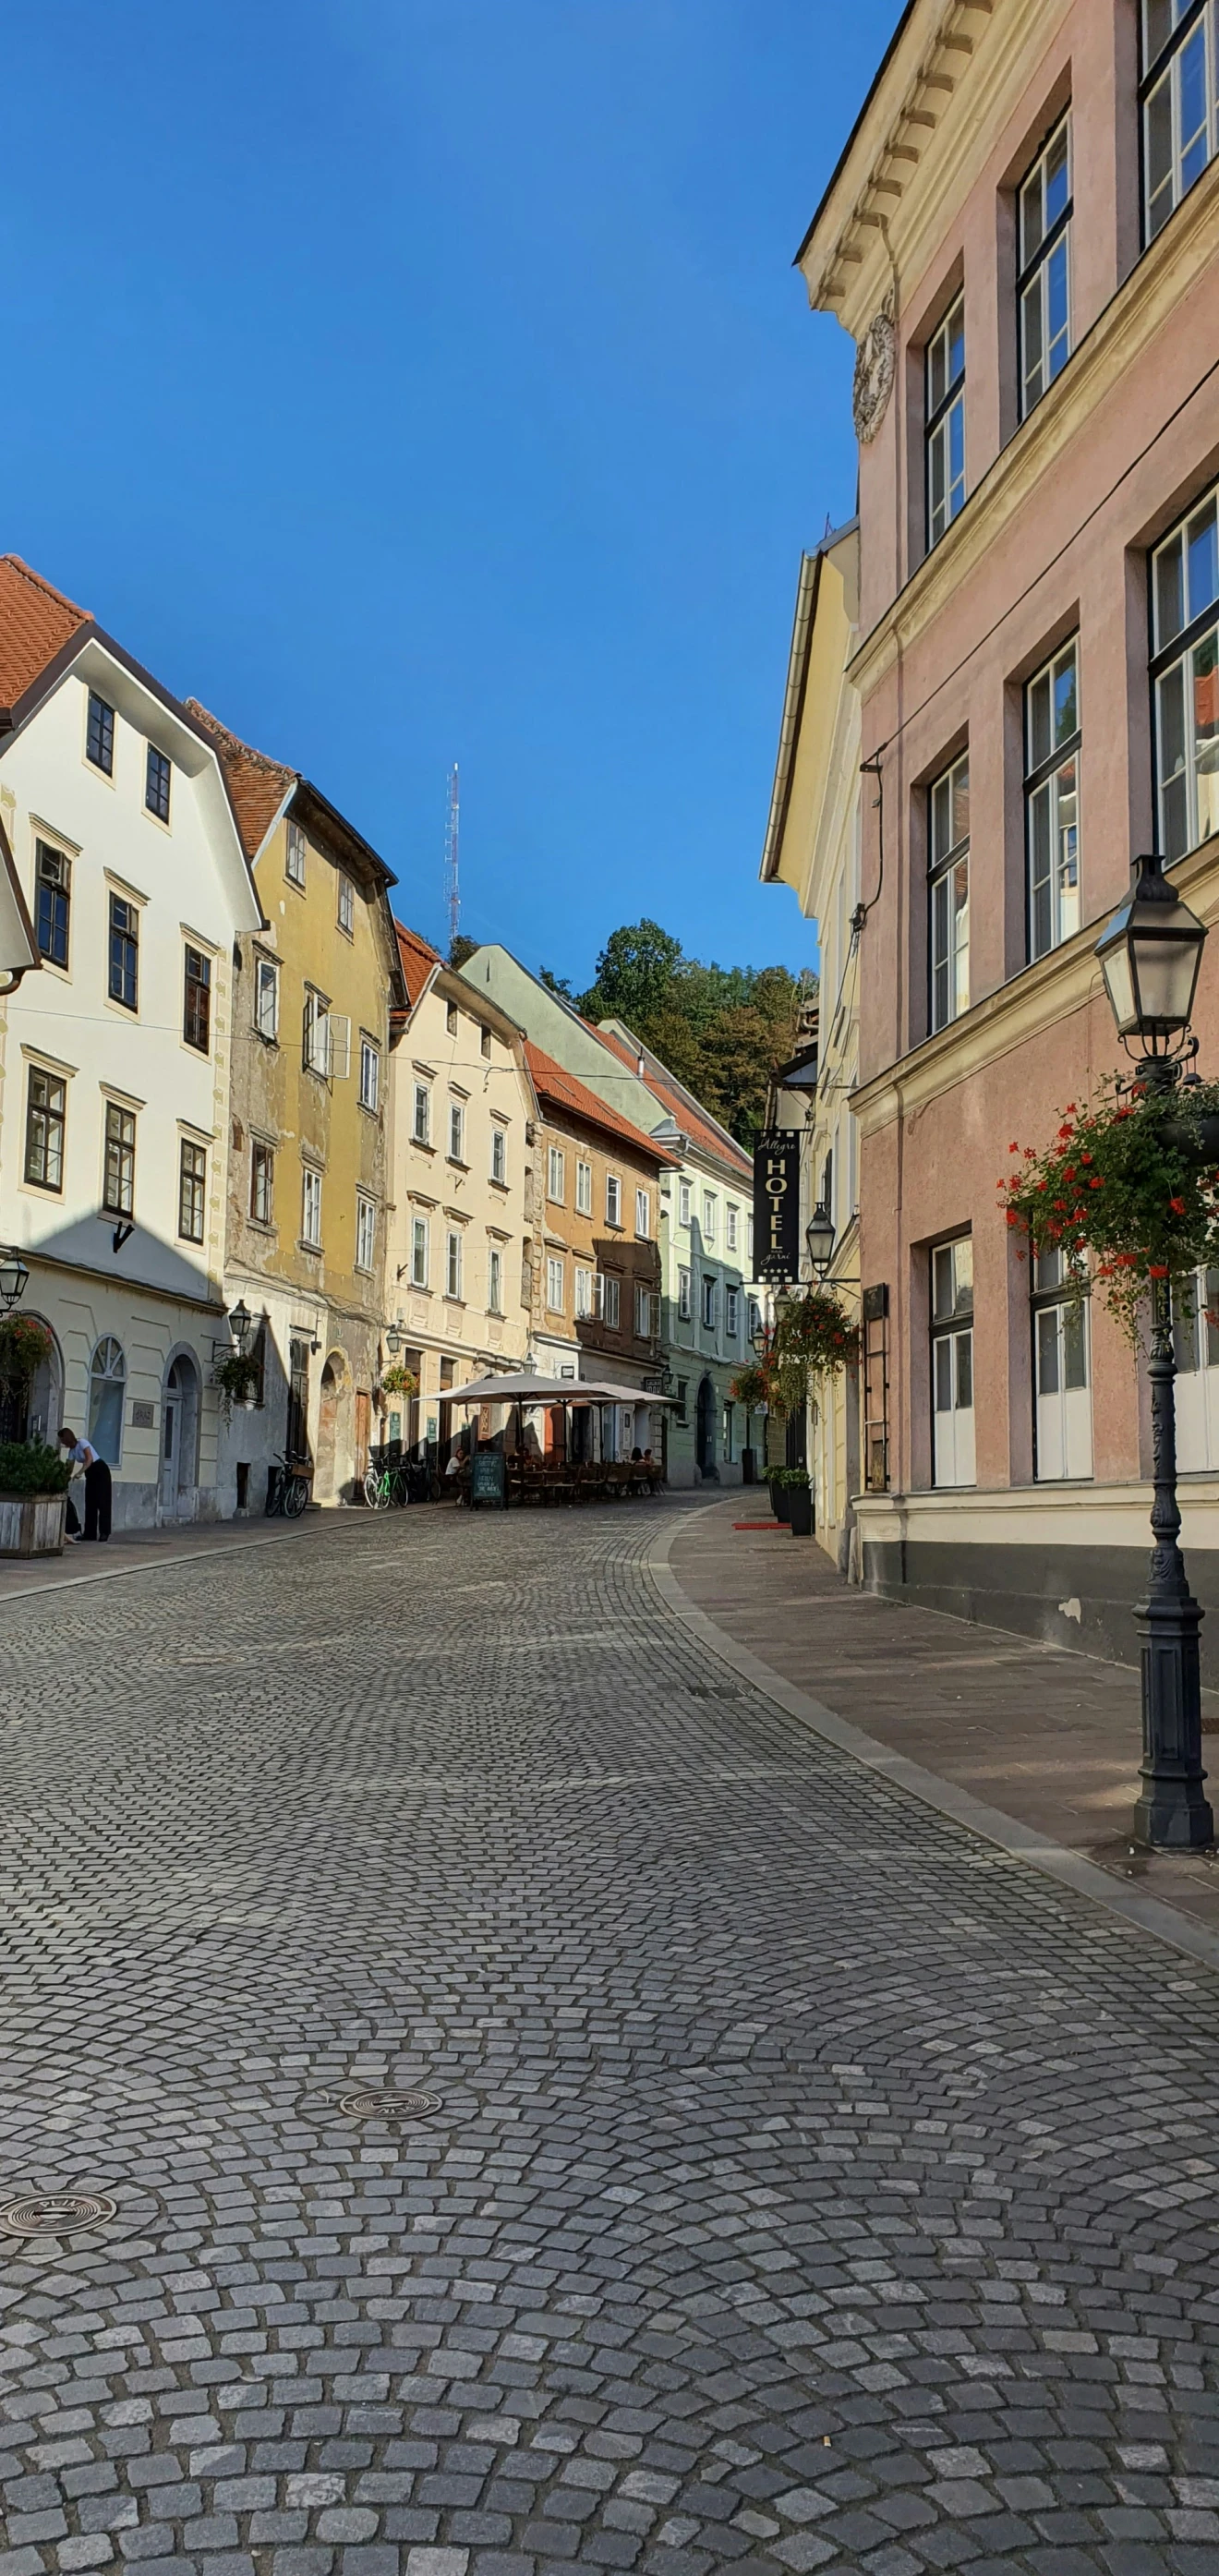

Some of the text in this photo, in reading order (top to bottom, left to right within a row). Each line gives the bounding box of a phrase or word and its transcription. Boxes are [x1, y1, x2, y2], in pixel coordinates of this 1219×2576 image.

[756, 1138, 796, 1155] Allegro
[765, 1159, 788, 1250] HOTEL
[760, 1252, 791, 1265] garni
[39, 2199, 81, 2208] PLIN
